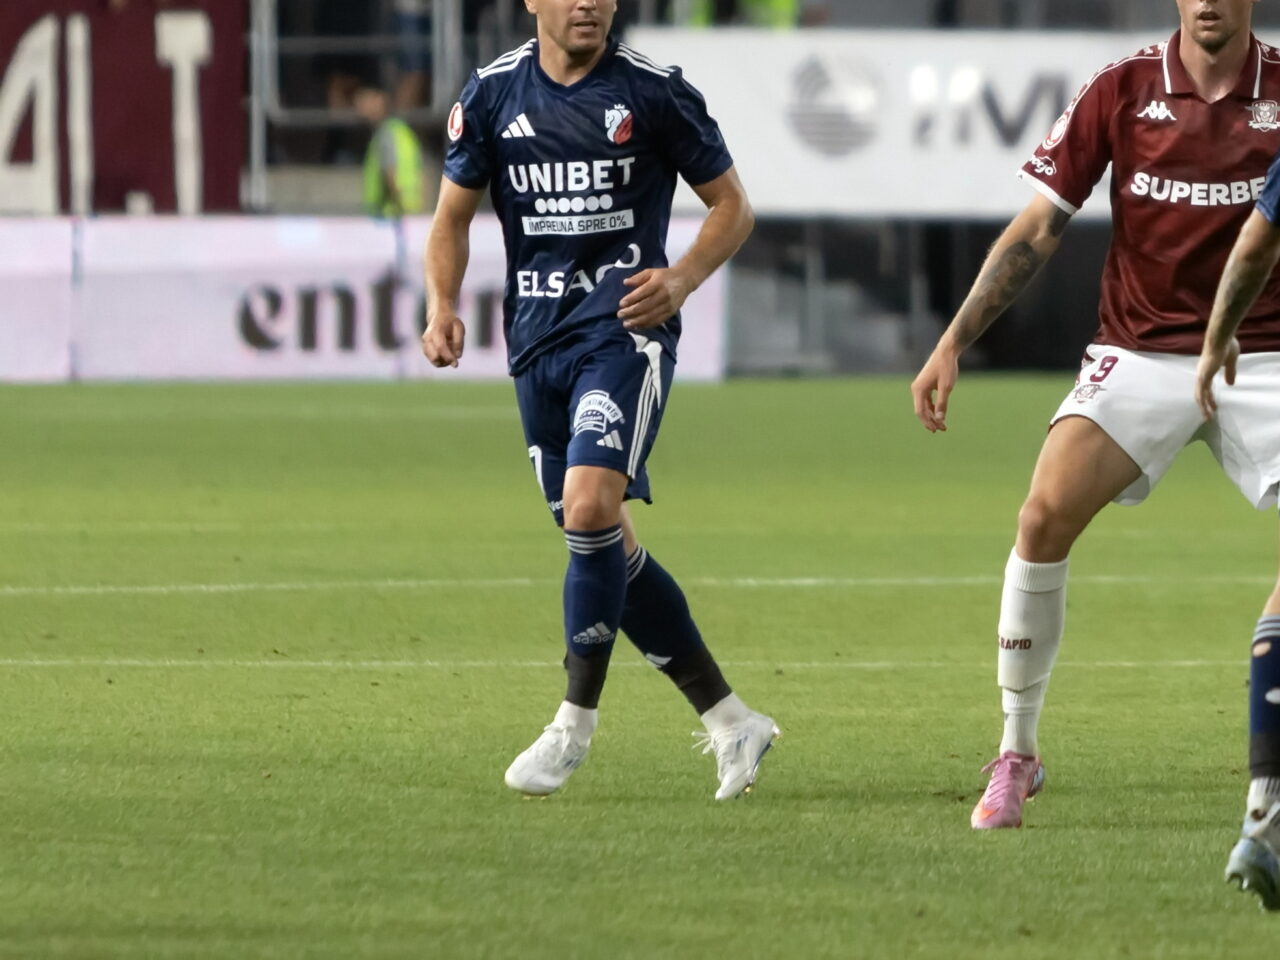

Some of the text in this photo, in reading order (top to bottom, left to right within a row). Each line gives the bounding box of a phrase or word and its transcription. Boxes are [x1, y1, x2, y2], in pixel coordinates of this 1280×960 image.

[508, 157, 635, 193] UNIBET
[1130, 172, 1267, 206] SUPERBE
[578, 218, 607, 232] SPRE
[609, 215, 627, 228] 0%
[1089, 355, 1119, 383] 9
